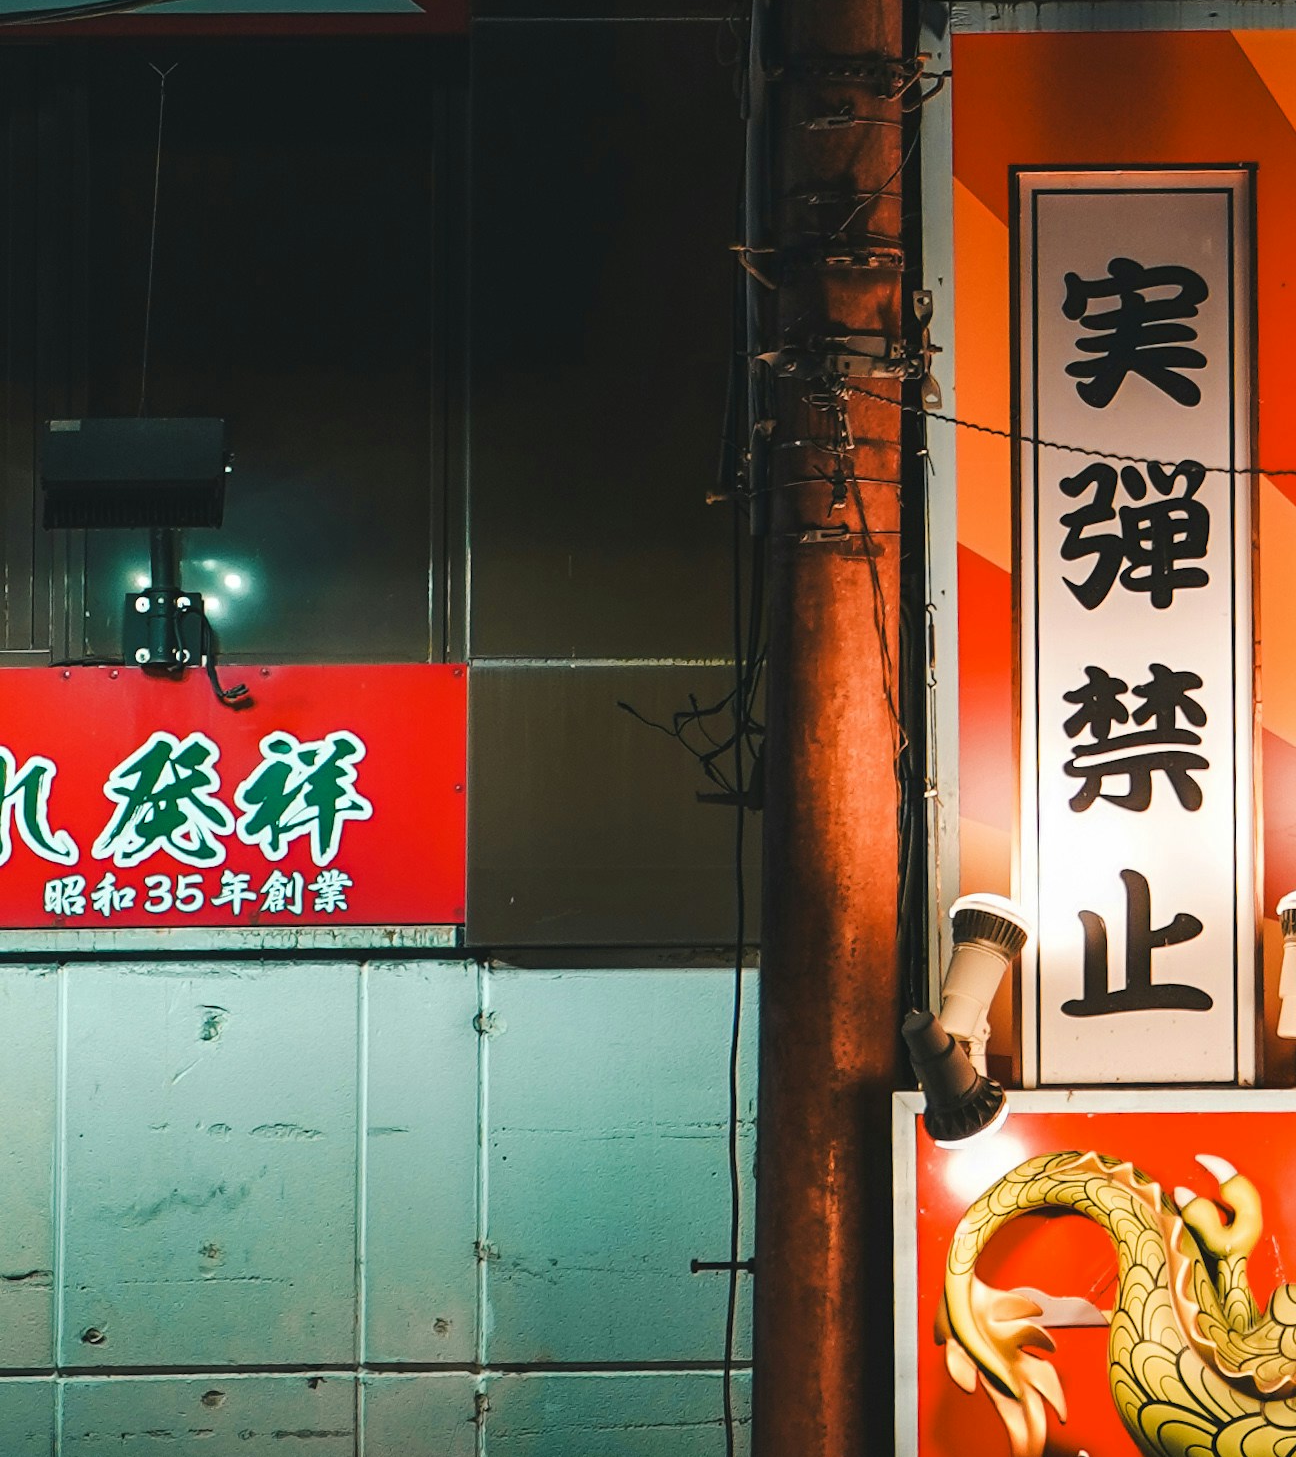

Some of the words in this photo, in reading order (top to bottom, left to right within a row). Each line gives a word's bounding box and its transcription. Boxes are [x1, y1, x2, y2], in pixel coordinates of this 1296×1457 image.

[1059, 256, 1215, 1019] 実弾禁止
[43, 868, 354, 917] 昭和35年創業
